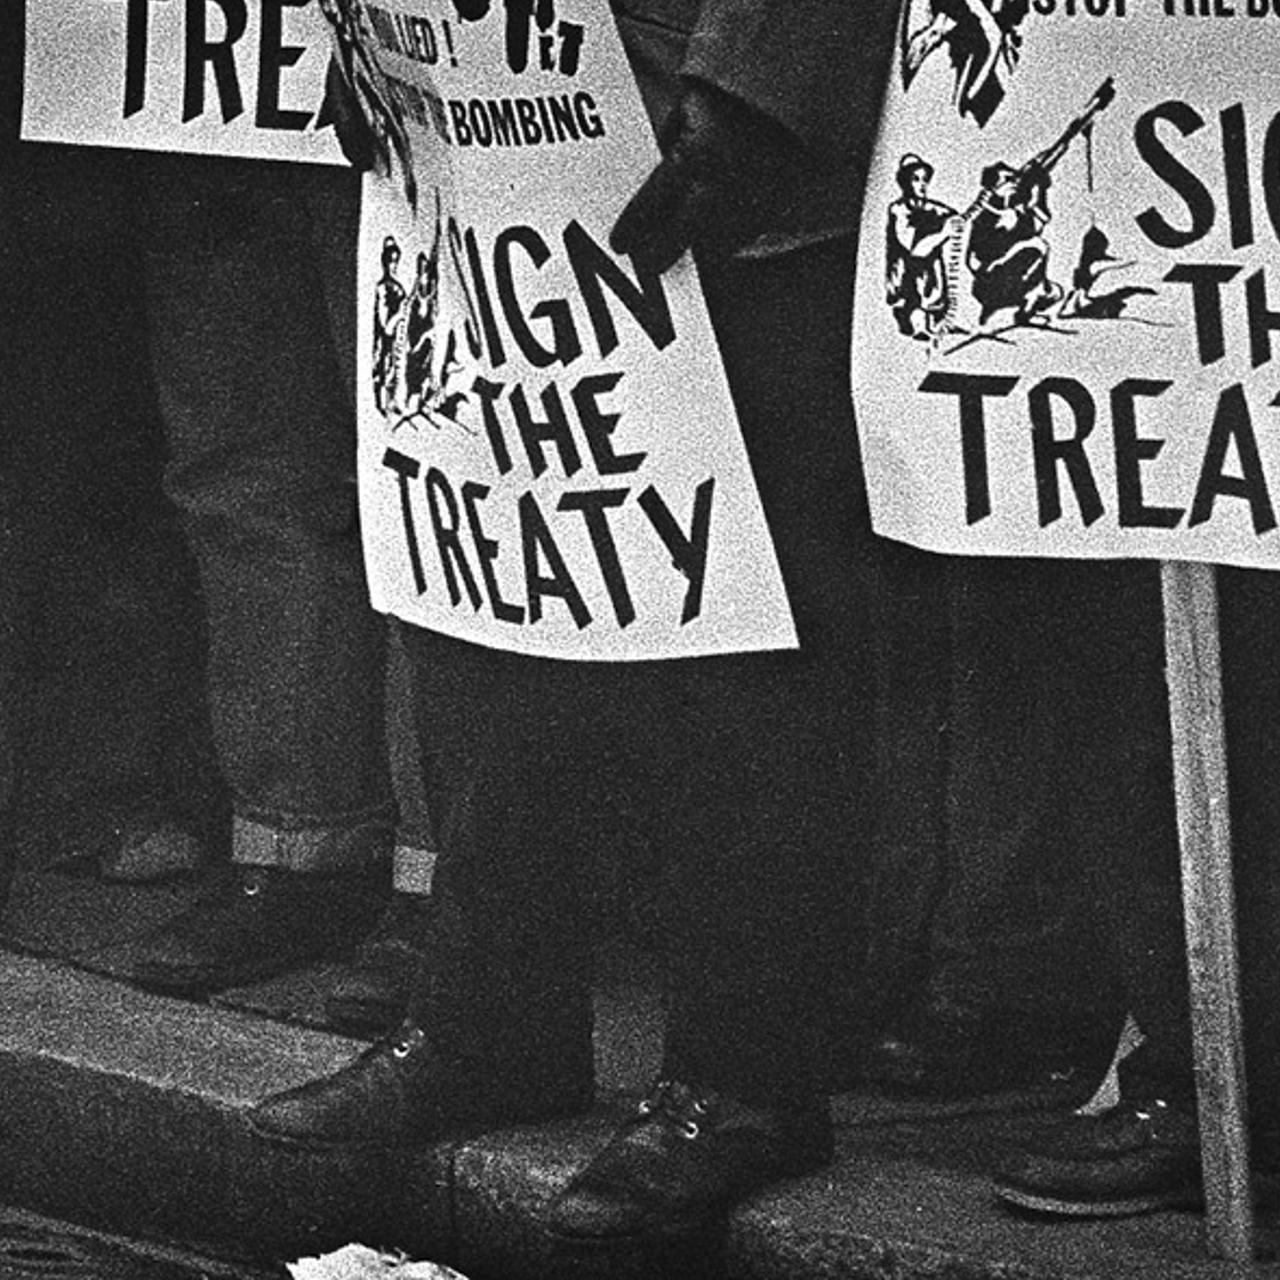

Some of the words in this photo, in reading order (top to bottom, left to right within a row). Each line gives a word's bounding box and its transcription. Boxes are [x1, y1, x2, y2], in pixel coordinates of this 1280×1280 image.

[450, 92, 605, 148] BOMBING
[1134, 100, 1280, 250] SI
[449, 217, 677, 371] SIGN
[473, 371, 647, 478] THE
[917, 371, 1280, 536] TREA
[381, 447, 714, 630] TREATY
